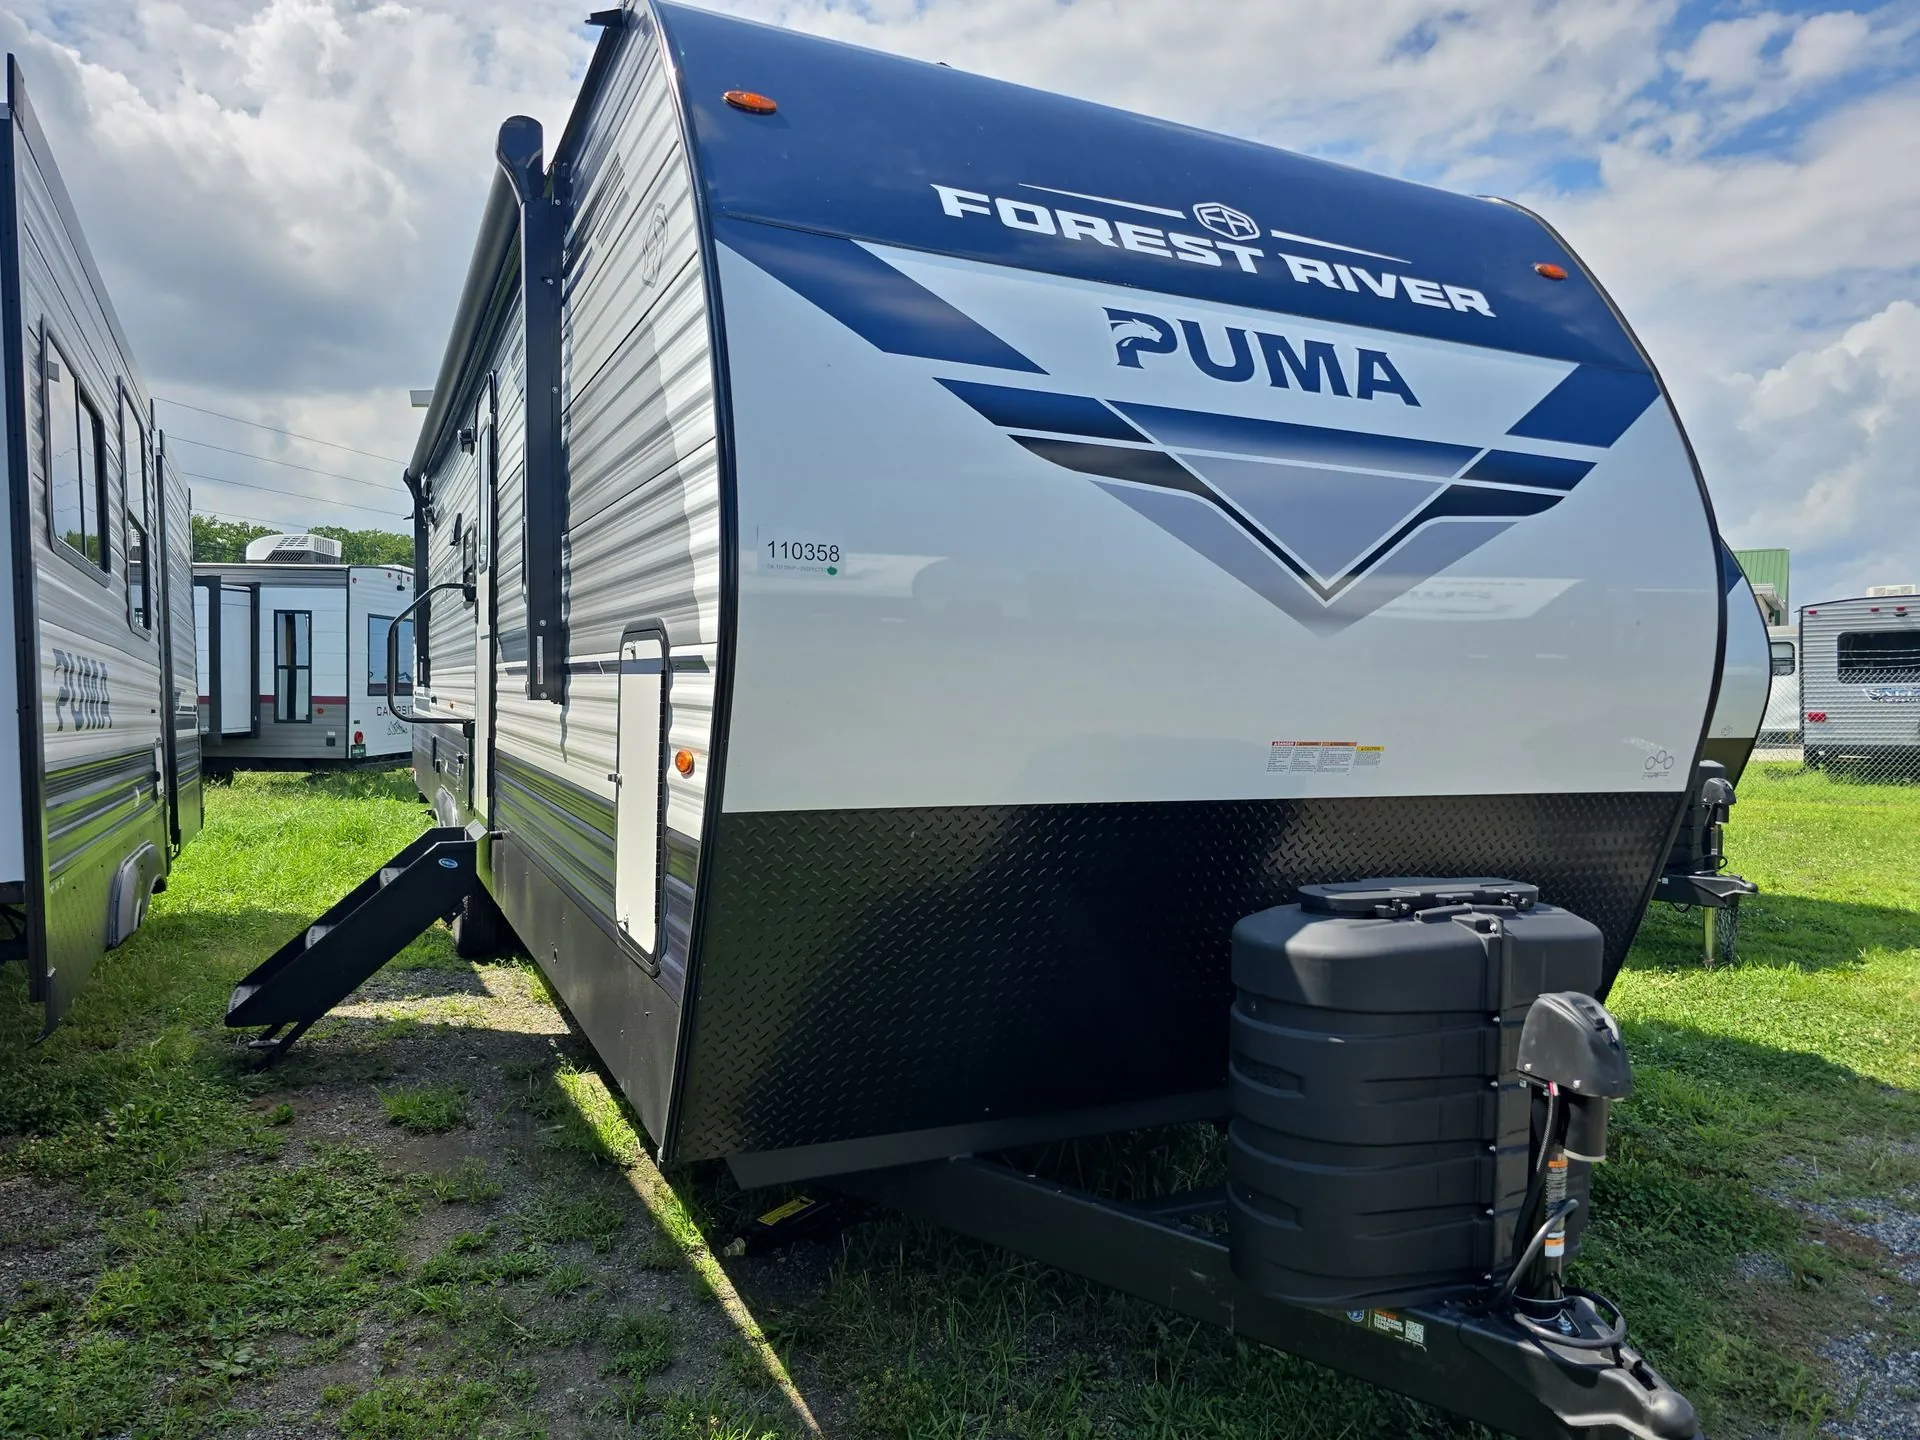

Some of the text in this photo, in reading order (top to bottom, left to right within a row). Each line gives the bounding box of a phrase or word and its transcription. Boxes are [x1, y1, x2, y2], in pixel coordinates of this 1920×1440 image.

[930, 183, 1497, 318] FOREST RIVER
[1102, 306, 1422, 408] PUMA
[767, 540, 840, 562] 110358
[52, 648, 112, 731] PUMA
